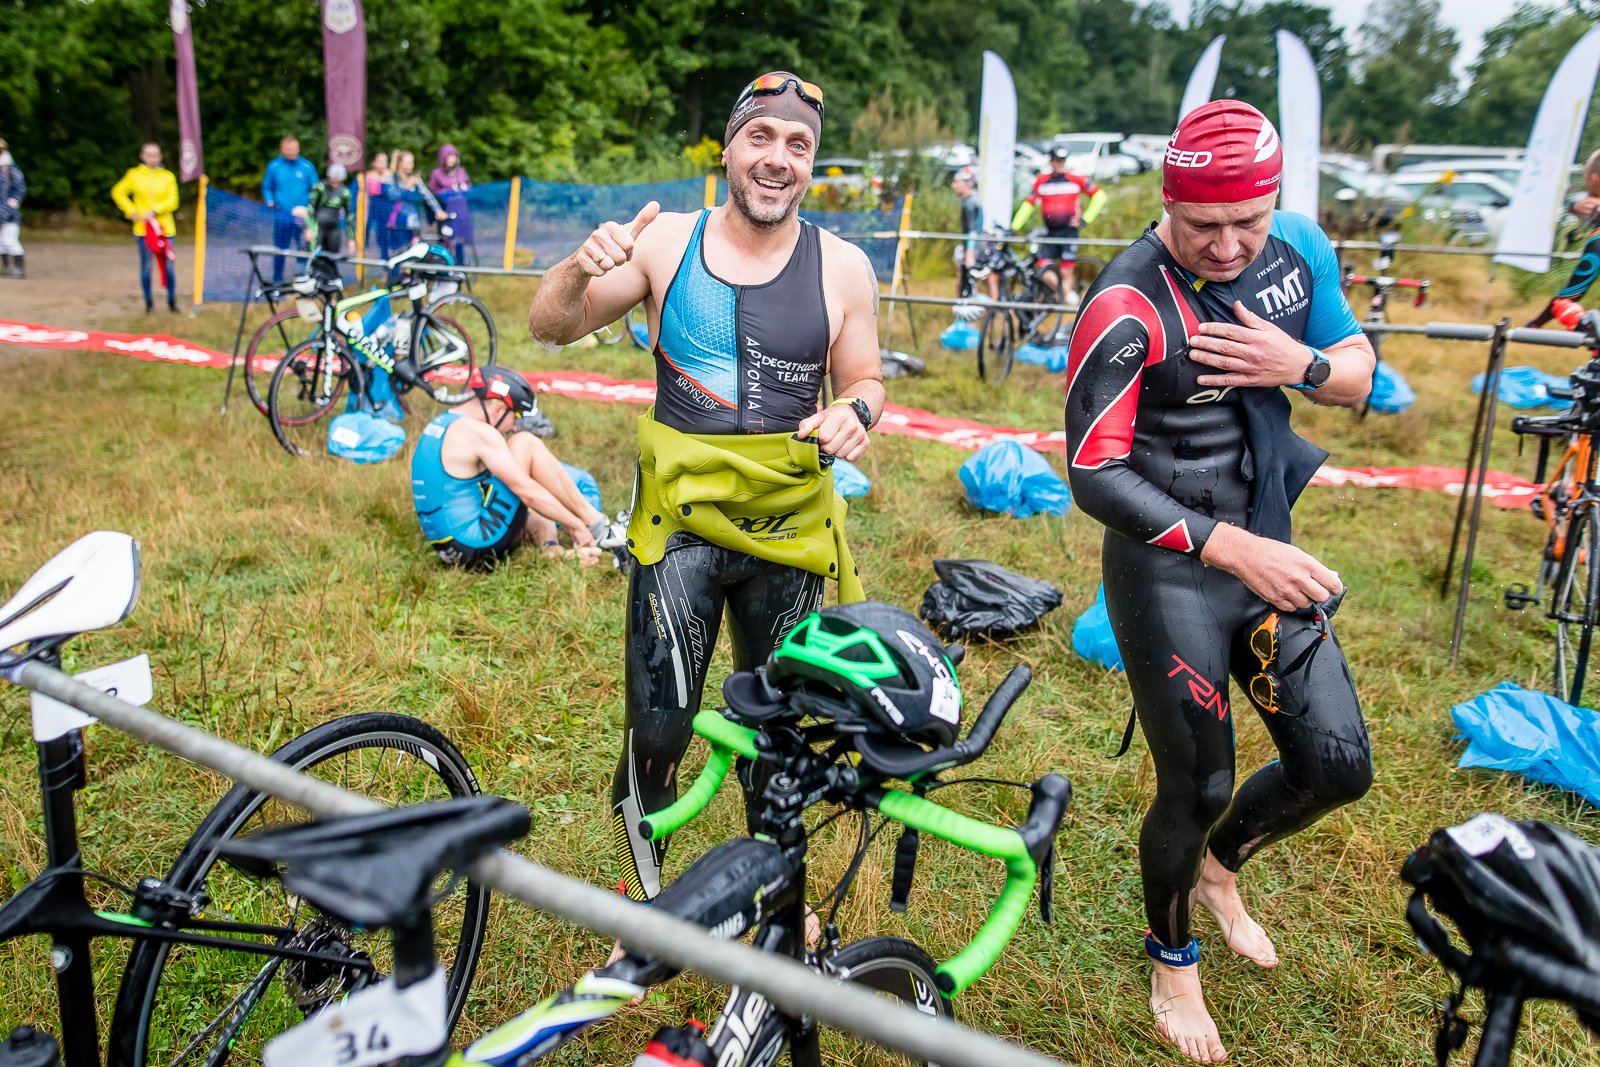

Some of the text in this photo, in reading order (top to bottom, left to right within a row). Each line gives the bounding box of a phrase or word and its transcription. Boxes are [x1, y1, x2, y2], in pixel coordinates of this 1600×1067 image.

[1255, 266, 1301, 315] TMT
[760, 356, 822, 372] DECATHLON
[1108, 337, 1145, 366] TRN
[675, 374, 720, 411] KRZYSZTOF
[745, 336, 762, 410] APTONIA
[776, 370, 809, 383] TEAM
[1167, 654, 1229, 721] TRN
[333, 1024, 391, 1066] 34
